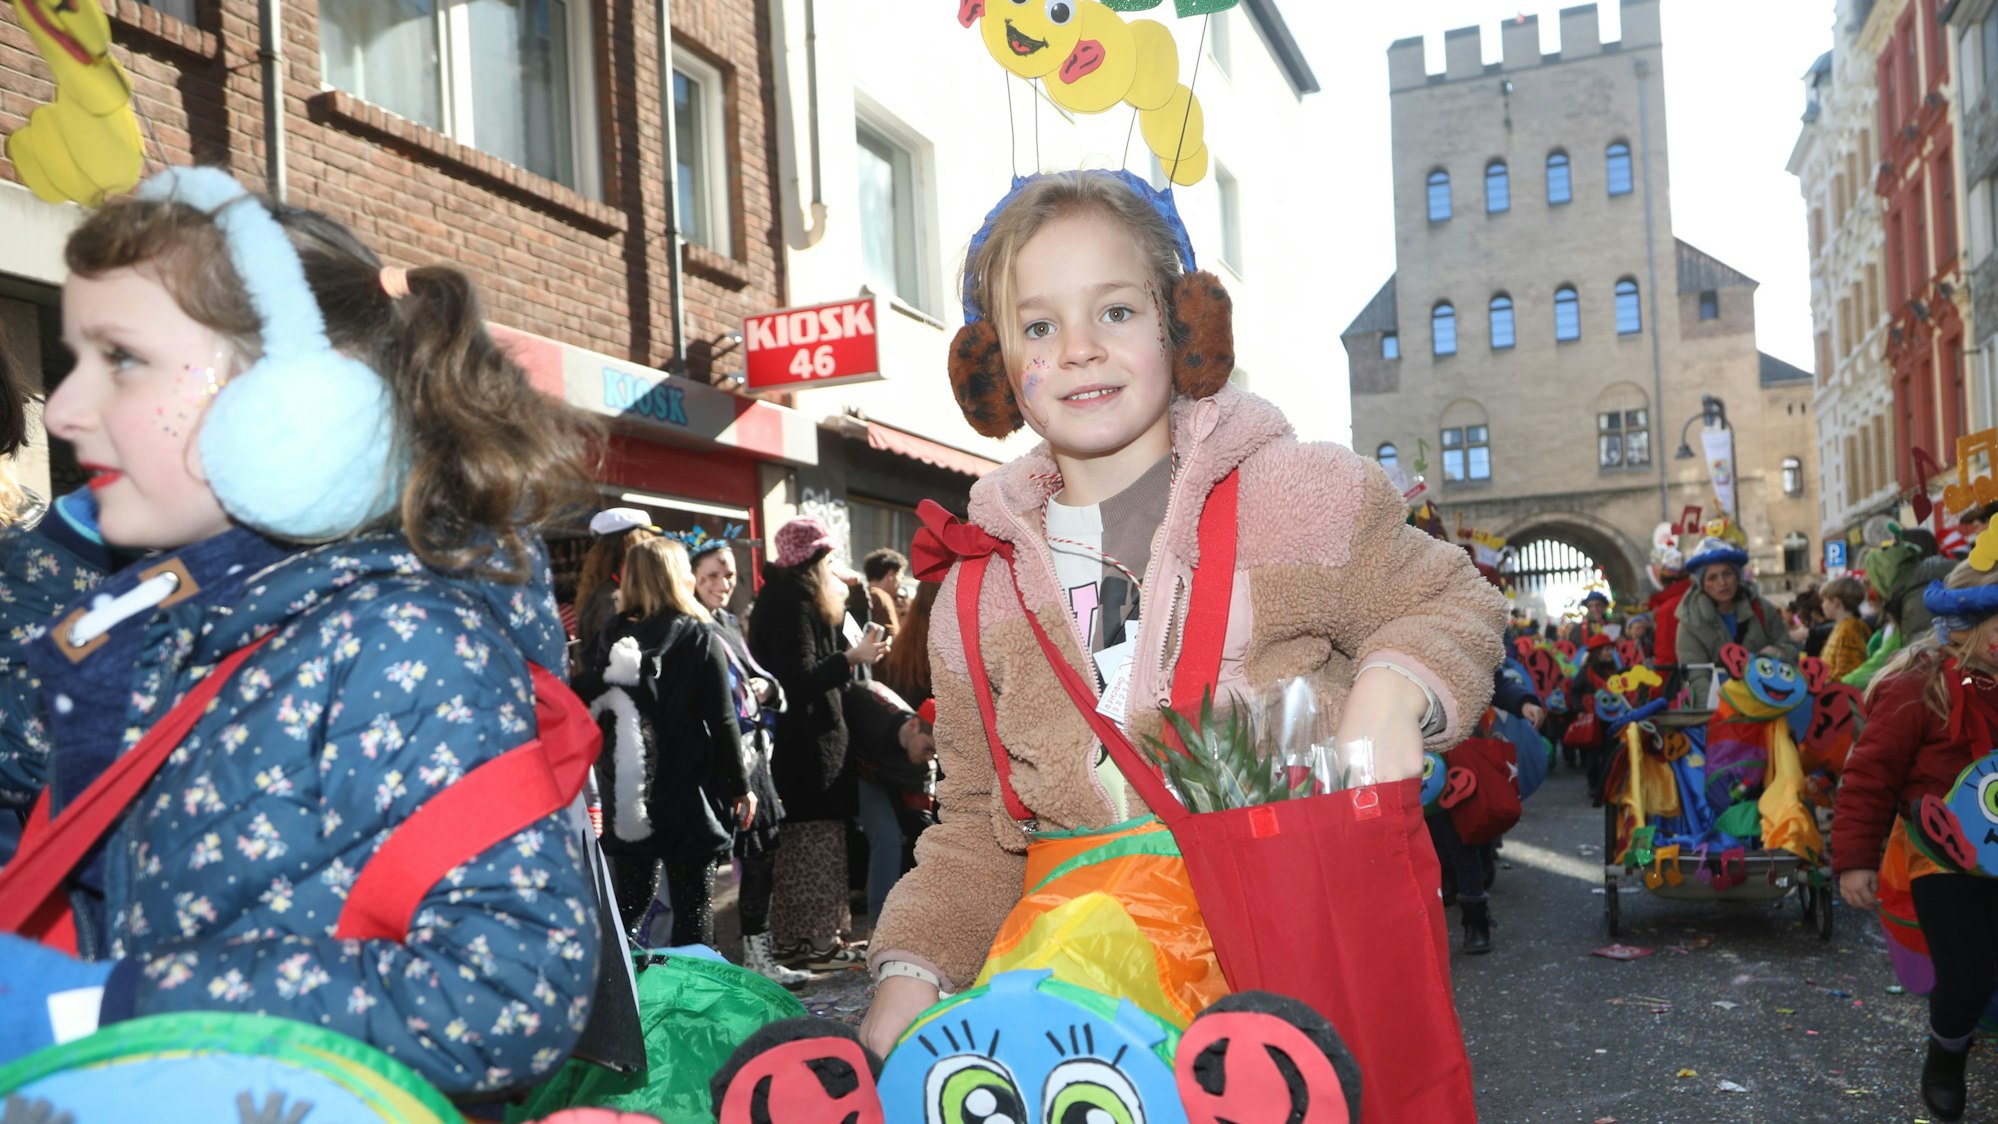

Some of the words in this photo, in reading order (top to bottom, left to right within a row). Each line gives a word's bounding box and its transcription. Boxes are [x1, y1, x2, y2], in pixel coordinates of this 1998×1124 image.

[747, 303, 874, 351] KIOSK
[789, 346, 835, 378] 46
[602, 367, 688, 425] KIOSK
[1829, 544, 1840, 563] P
